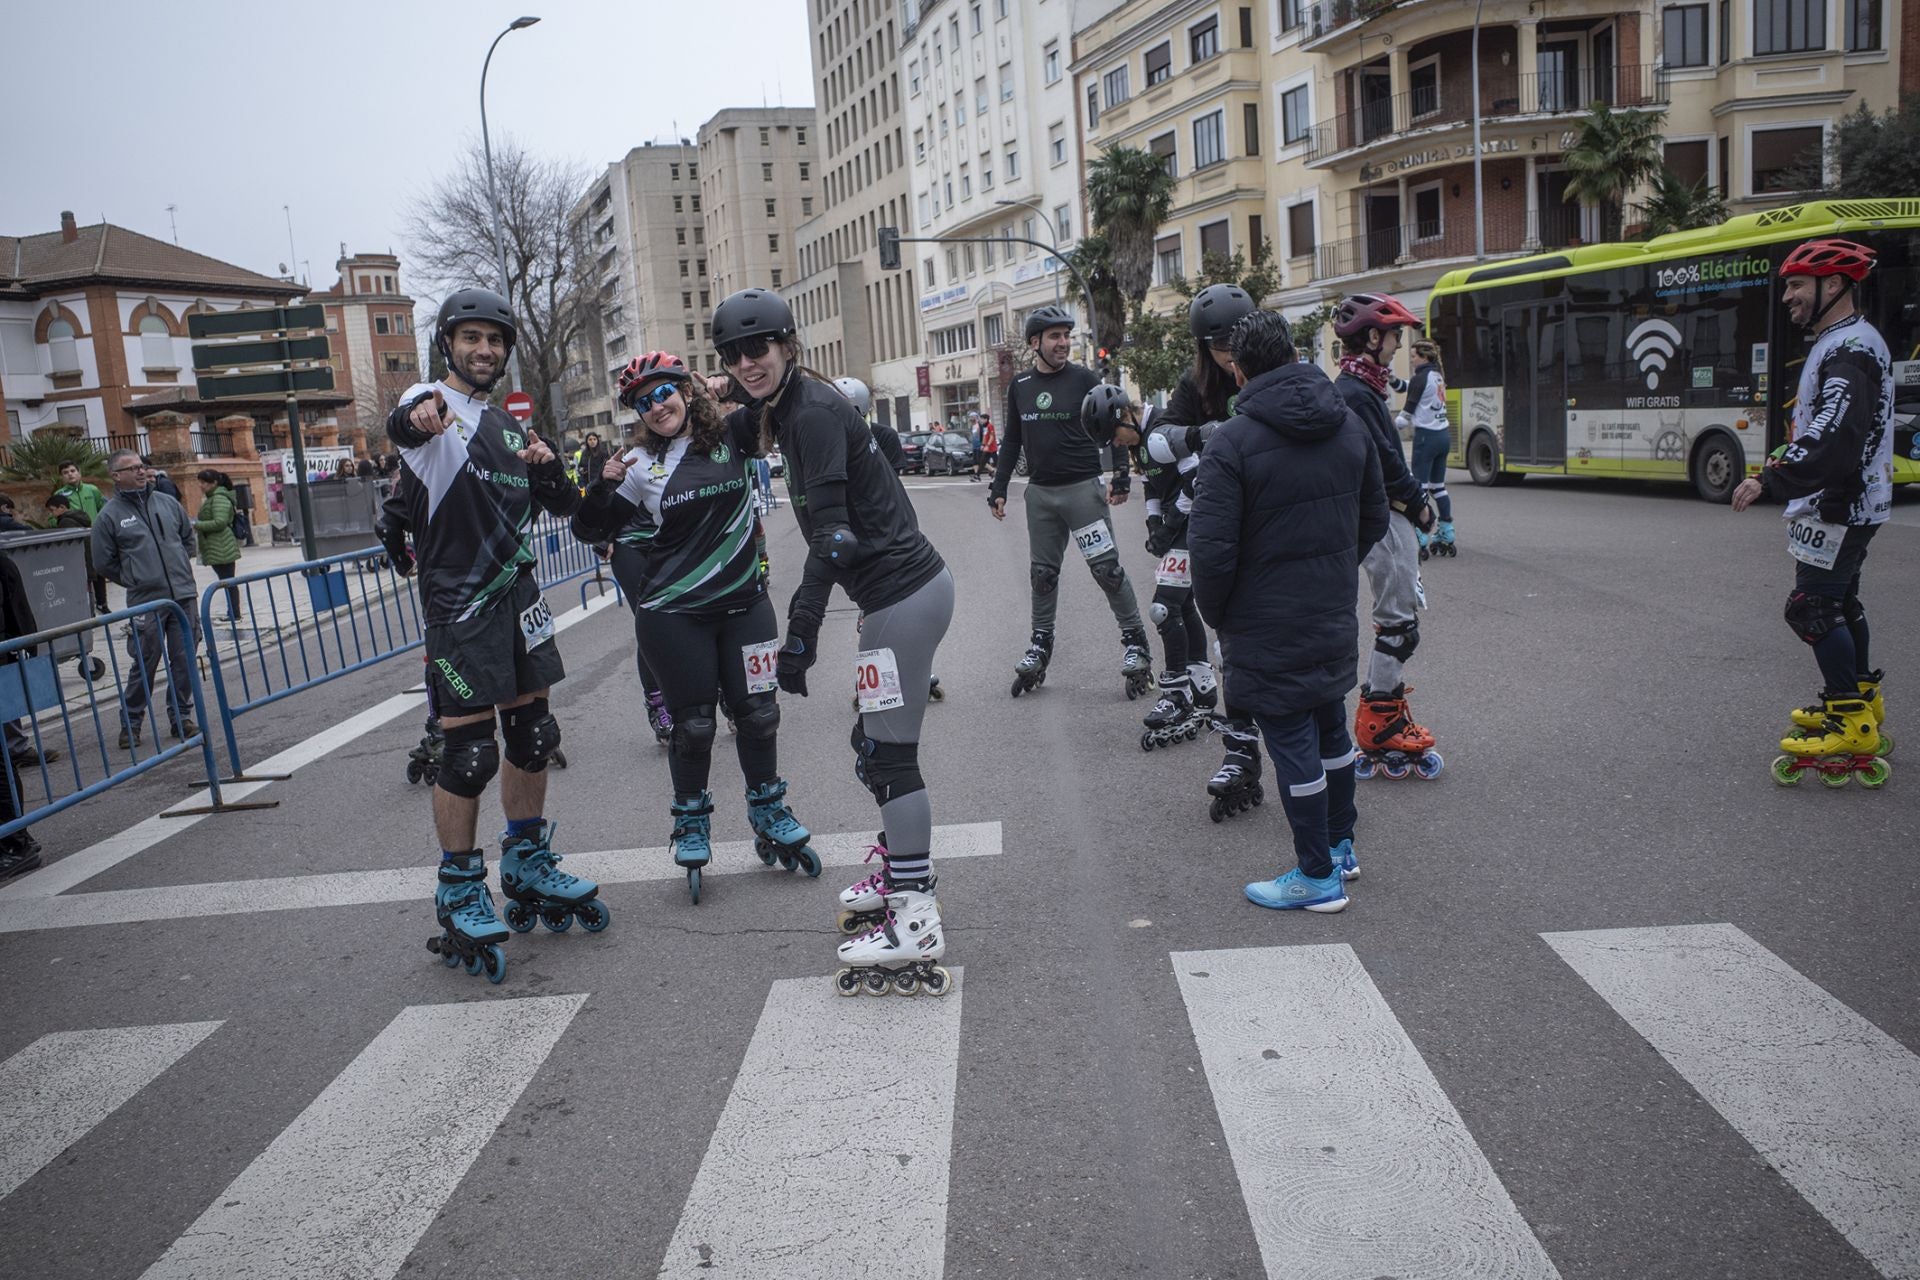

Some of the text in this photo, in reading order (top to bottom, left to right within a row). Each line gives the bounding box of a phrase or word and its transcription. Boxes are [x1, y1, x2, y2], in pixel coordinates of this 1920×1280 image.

[1455, 140, 1518, 158] DENTAL
[1700, 255, 1770, 281] Eléctrico
[1626, 396, 1680, 408] WIFI GRATIS
[1785, 442, 1809, 462] 23
[492, 472, 529, 488] BADAJOZ
[662, 478, 745, 510] INLINE BADAJOZ
[1788, 521, 1826, 549] 3008
[1814, 557, 1831, 566] HOY
[435, 658, 474, 699] ADIZERO
[879, 696, 898, 707] HOY
